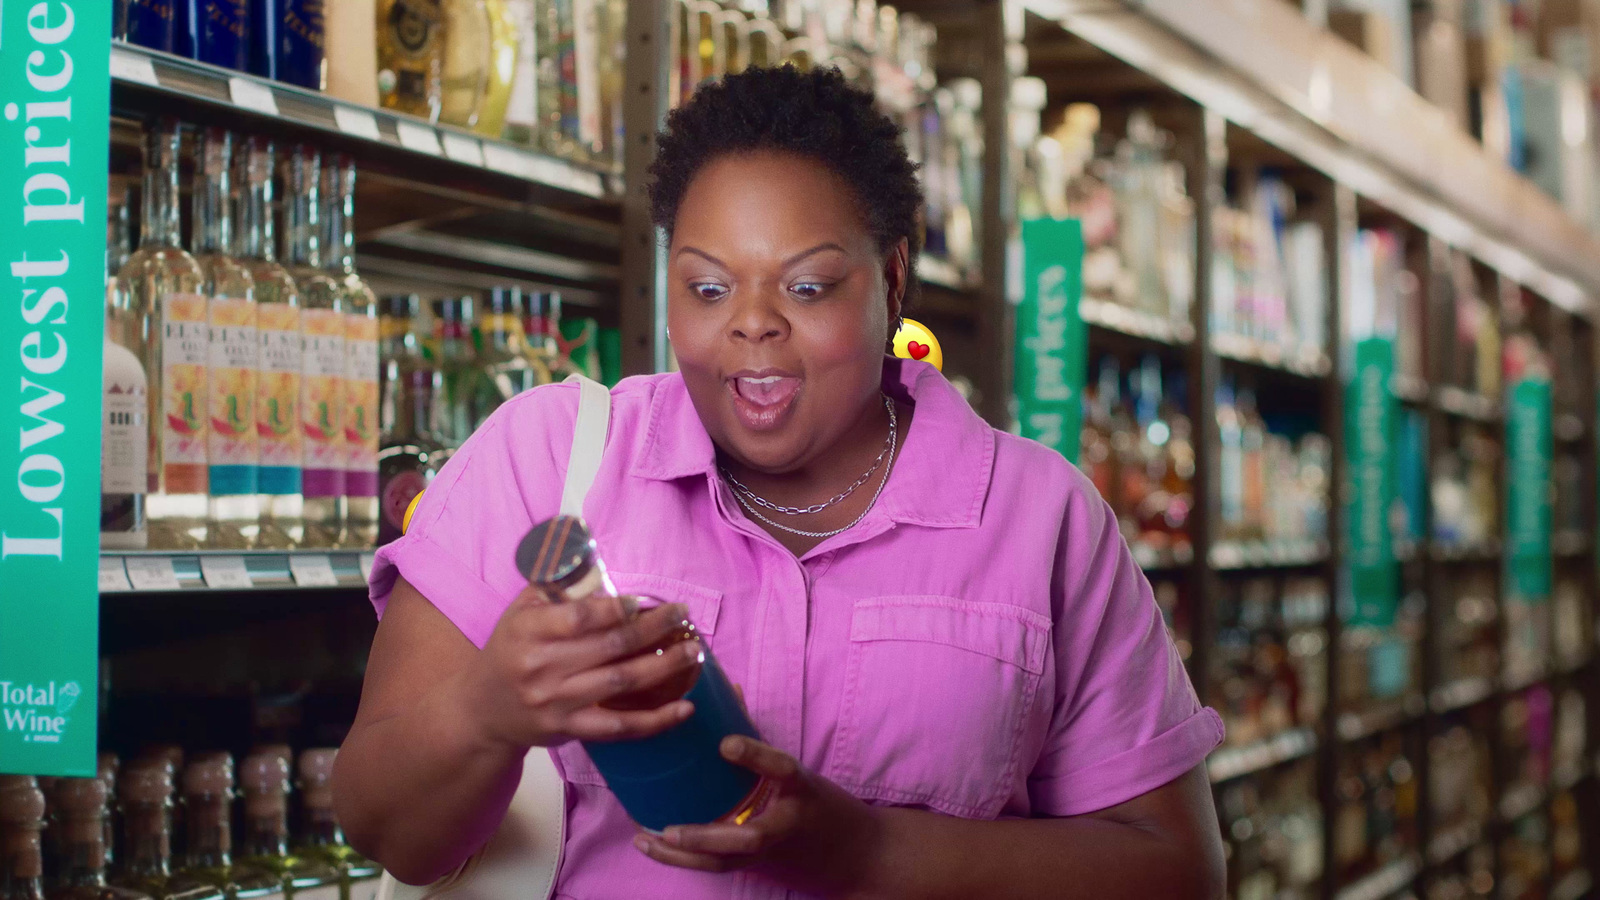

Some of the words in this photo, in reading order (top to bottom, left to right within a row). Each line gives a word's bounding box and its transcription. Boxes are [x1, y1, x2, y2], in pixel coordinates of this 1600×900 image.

[4, 0, 86, 226] price
[1, 248, 70, 562] Lowest
[0, 680, 55, 706] Total
[3, 708, 66, 734] Wine
